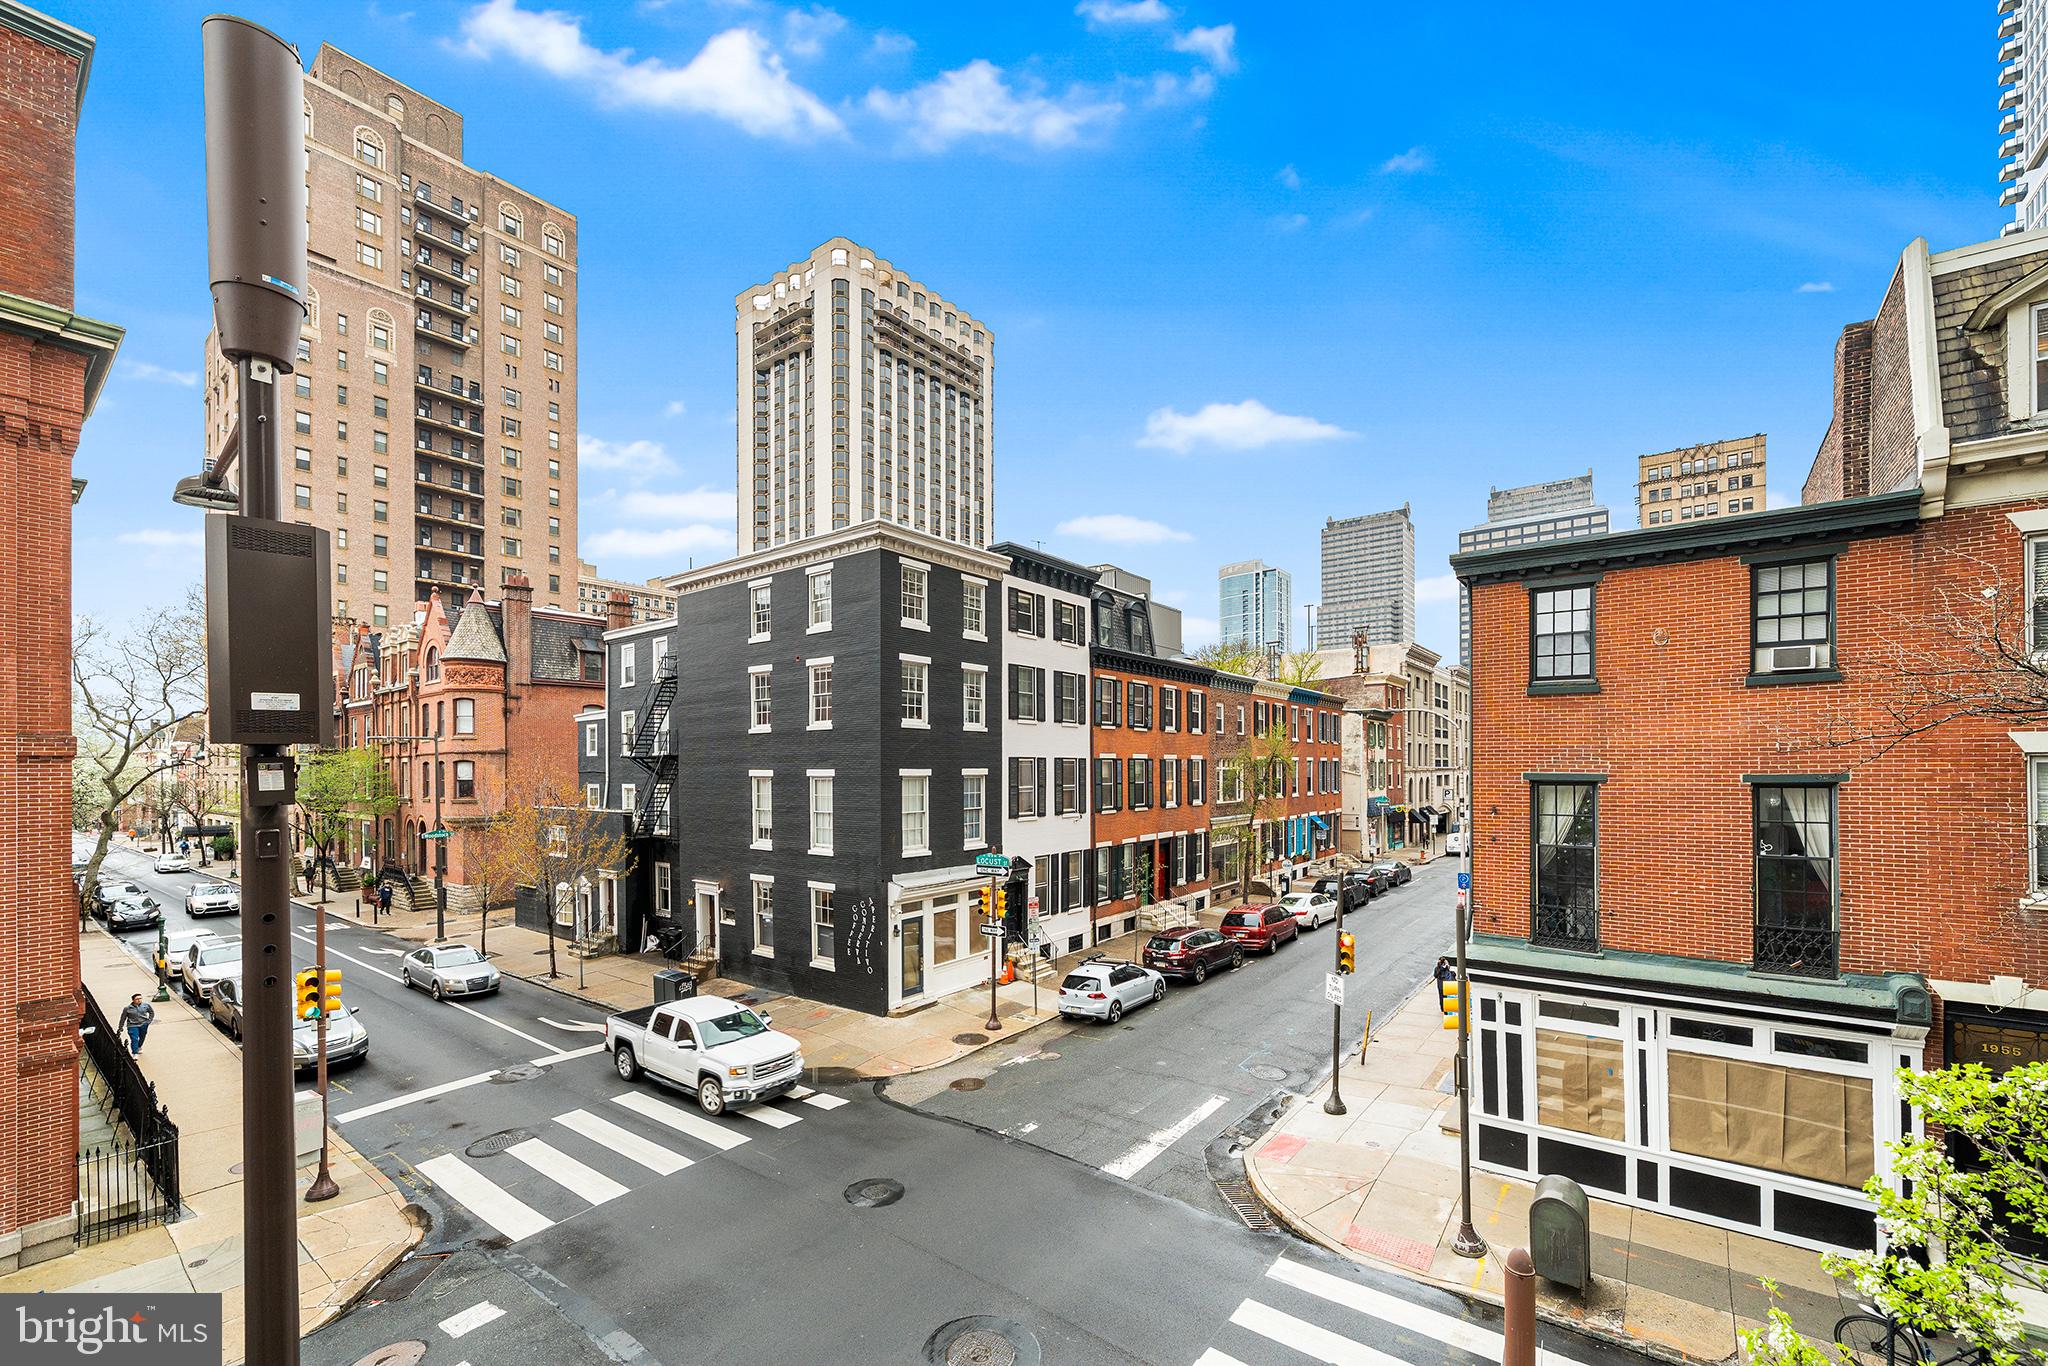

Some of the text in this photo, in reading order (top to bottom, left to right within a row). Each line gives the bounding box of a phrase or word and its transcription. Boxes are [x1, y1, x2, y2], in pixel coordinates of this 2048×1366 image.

[976, 857, 1001, 865] LOCUST
[847, 905, 858, 956] COFFEE
[855, 900, 868, 965] CONSERVA
[865, 897, 875, 974] APERITIVO
[1329, 984, 1341, 993] TURN
[1981, 1043, 2022, 1057] 1955
